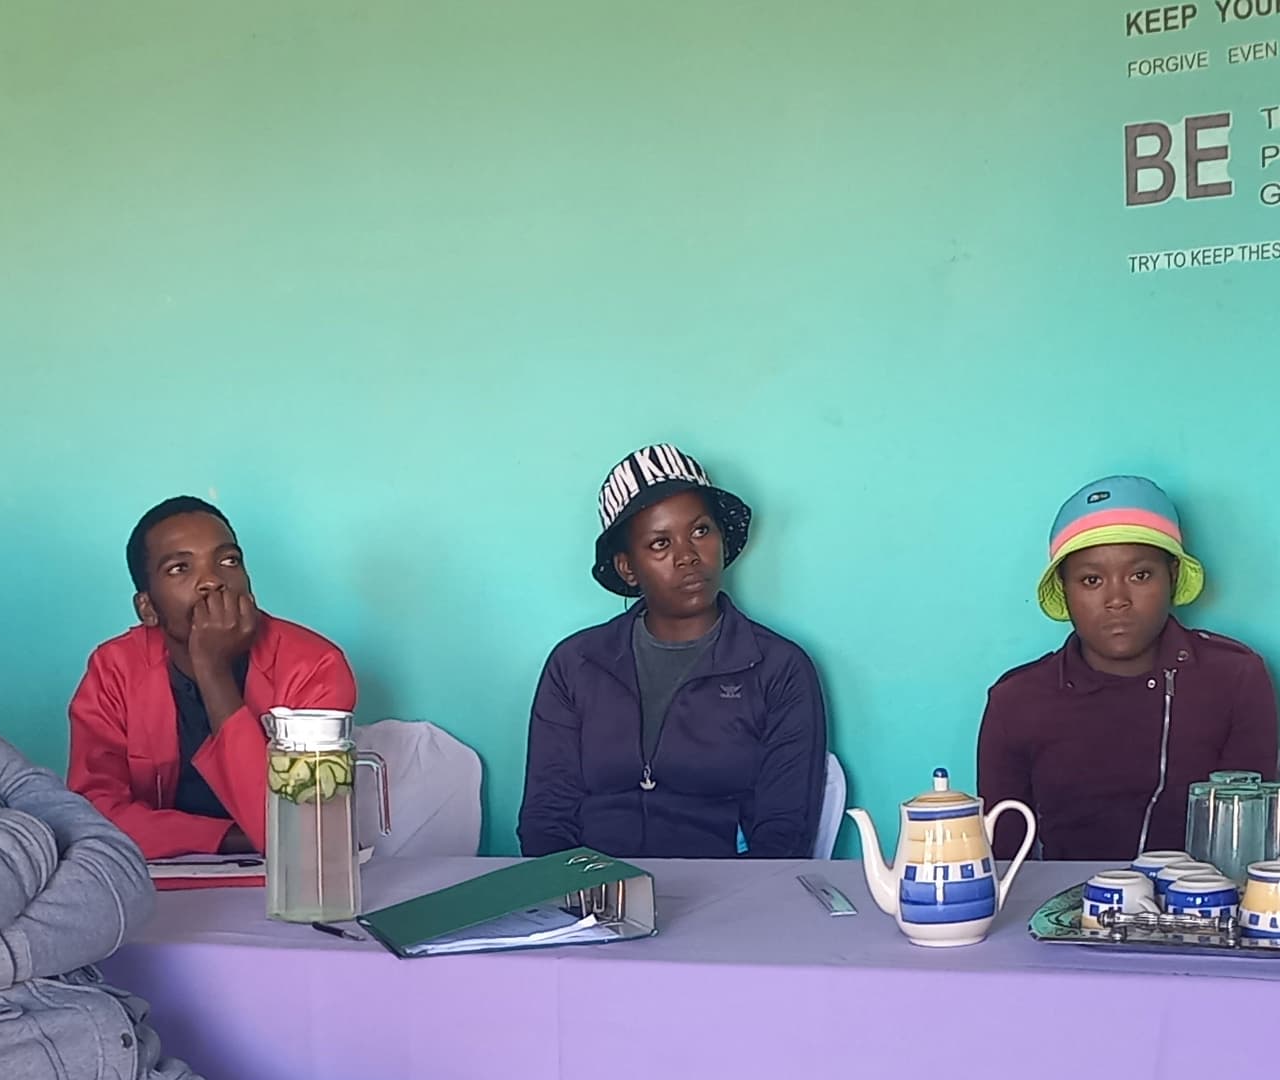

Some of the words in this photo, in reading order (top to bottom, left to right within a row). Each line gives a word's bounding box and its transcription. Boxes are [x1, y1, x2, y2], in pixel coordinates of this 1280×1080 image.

[1126, 4, 1197, 36] KEEP
[1128, 51, 1209, 78] FORGIVE
[1228, 41, 1278, 64] EVEN
[1124, 112, 1233, 206] BE
[1129, 254, 1160, 273] TRY
[1164, 251, 1187, 268] TO
[1191, 247, 1235, 267] KEEP
